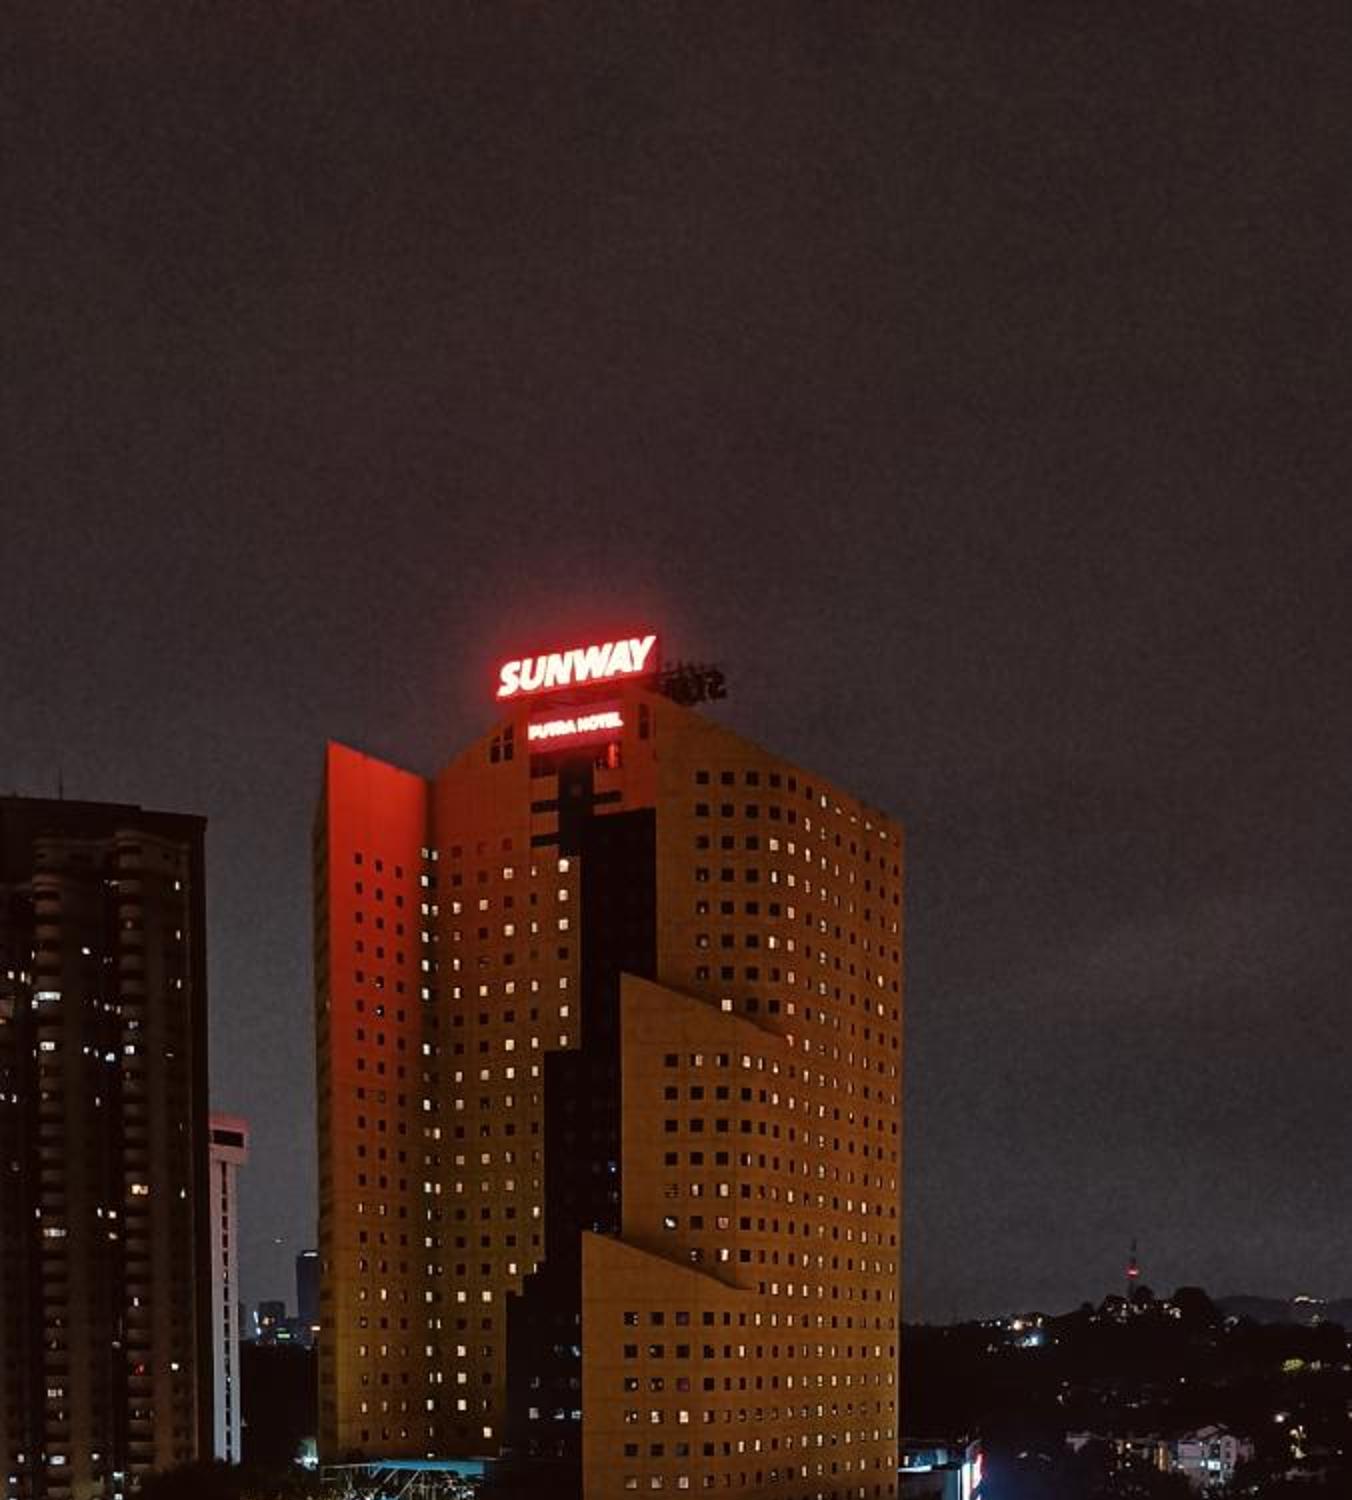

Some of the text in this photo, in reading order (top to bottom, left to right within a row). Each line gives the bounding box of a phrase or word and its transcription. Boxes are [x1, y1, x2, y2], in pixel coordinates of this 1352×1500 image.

[498, 636, 656, 696] SUNWAY
[528, 712, 623, 740] PUTRA HOTEL
